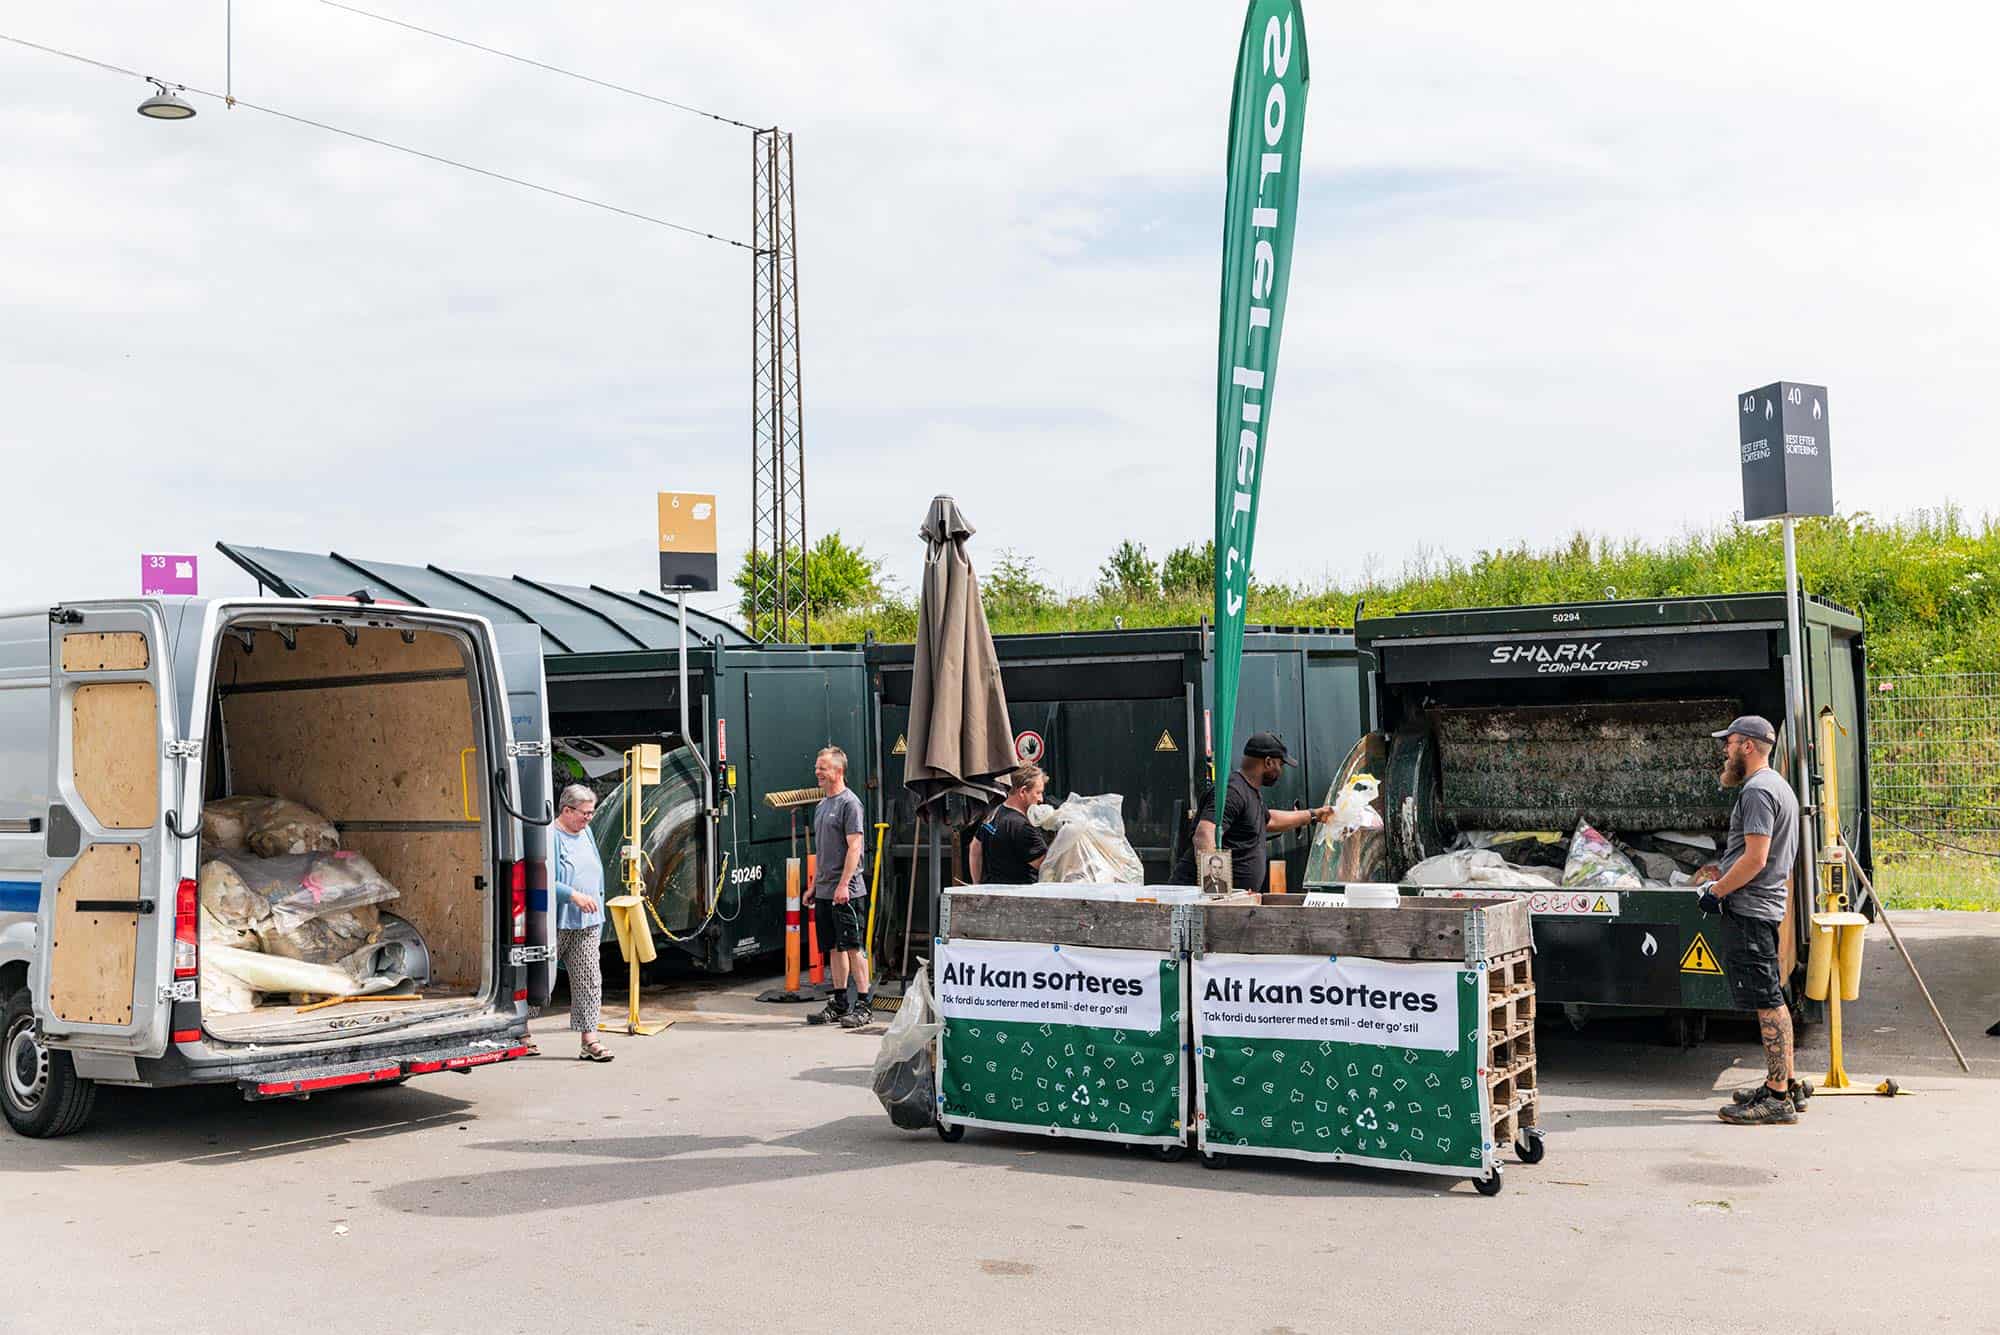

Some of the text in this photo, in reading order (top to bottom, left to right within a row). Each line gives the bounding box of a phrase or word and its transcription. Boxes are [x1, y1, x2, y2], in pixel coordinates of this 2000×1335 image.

[1743, 395, 1755, 413] 40
[1788, 388, 1802, 405] 40
[1785, 445, 1818, 457] SORTERING
[671, 496, 680, 508] 6
[150, 556, 166, 568] 33
[1552, 612, 1580, 623] 50294
[1489, 642, 1603, 664] SHARK
[730, 865, 763, 884] 50246
[942, 962, 1144, 997] Alt kan sorteres
[1203, 977, 1438, 1013] Alt kan sorteres
[955, 995, 974, 1005] fordi
[974, 997, 985, 1006] du
[986, 998, 1019, 1008] sorterer
[1020, 1000, 1040, 1009] med
[1041, 1001, 1050, 1009] et
[1050, 1001, 1068, 1010] smil
[1073, 1002, 1089, 1012] det
[1114, 1005, 1128, 1015] stil
[1203, 1011, 1220, 1022] Tak
[1221, 1012, 1243, 1022] fordi
[1244, 1013, 1257, 1023] du
[1257, 1015, 1297, 1025] sorterer
[1297, 1015, 1319, 1025] med
[1319, 1017, 1328, 1025] et
[1329, 1016, 1350, 1027] smil
[1356, 1018, 1374, 1029] det
[1375, 1020, 1385, 1030] er
[1403, 1022, 1419, 1033] stil
